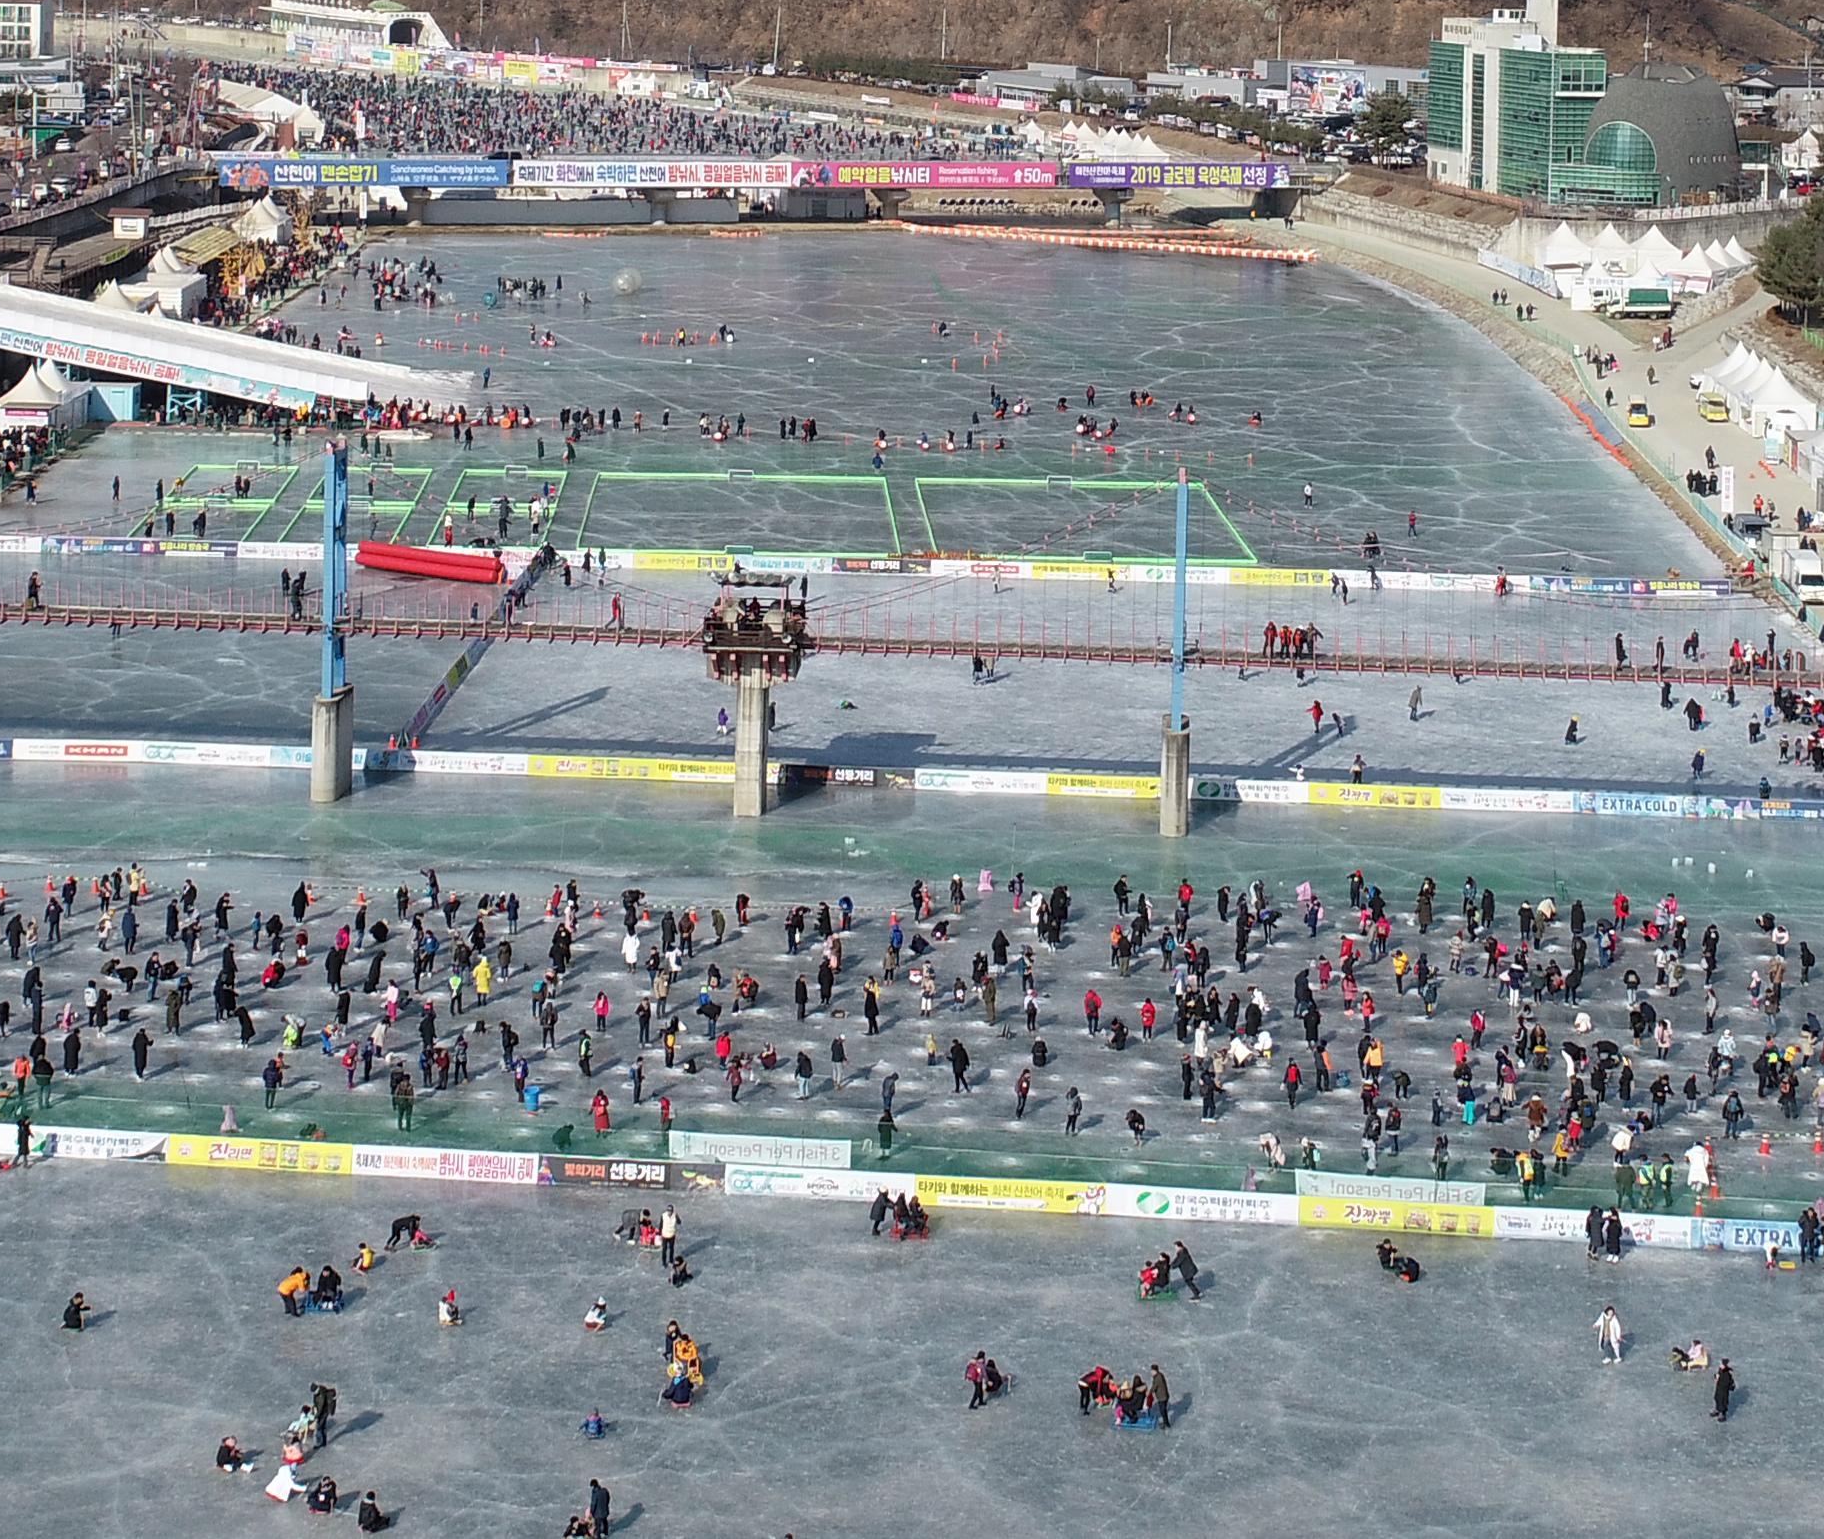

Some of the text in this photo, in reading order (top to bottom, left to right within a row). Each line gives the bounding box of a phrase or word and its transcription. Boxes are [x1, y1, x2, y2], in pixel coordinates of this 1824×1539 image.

[274, 164, 318, 182] 산천어
[320, 164, 378, 182] 맨손잡기
[434, 165, 464, 175] Catching
[518, 166, 554, 182] 축제기간
[556, 166, 594, 182] 화천에서
[596, 166, 637, 182] 숙박하면
[640, 166, 666, 182] 산천어
[704, 166, 763, 182] 평일얼음낚시
[838, 167, 930, 184] 예약얼음낚시터
[1023, 168, 1052, 183] 50m
[1130, 165, 1160, 183] 2019
[1163, 165, 1195, 185] 글로벌
[1602, 797, 1677, 813] EXTRA COLD
[356, 1153, 382, 1169] 축제기간
[610, 1162, 666, 1183] 선등거리
[918, 1180, 1065, 1199] 타키와 함께하는 화천 산천어 축제
[1733, 1227, 1793, 1249] EXTRA
